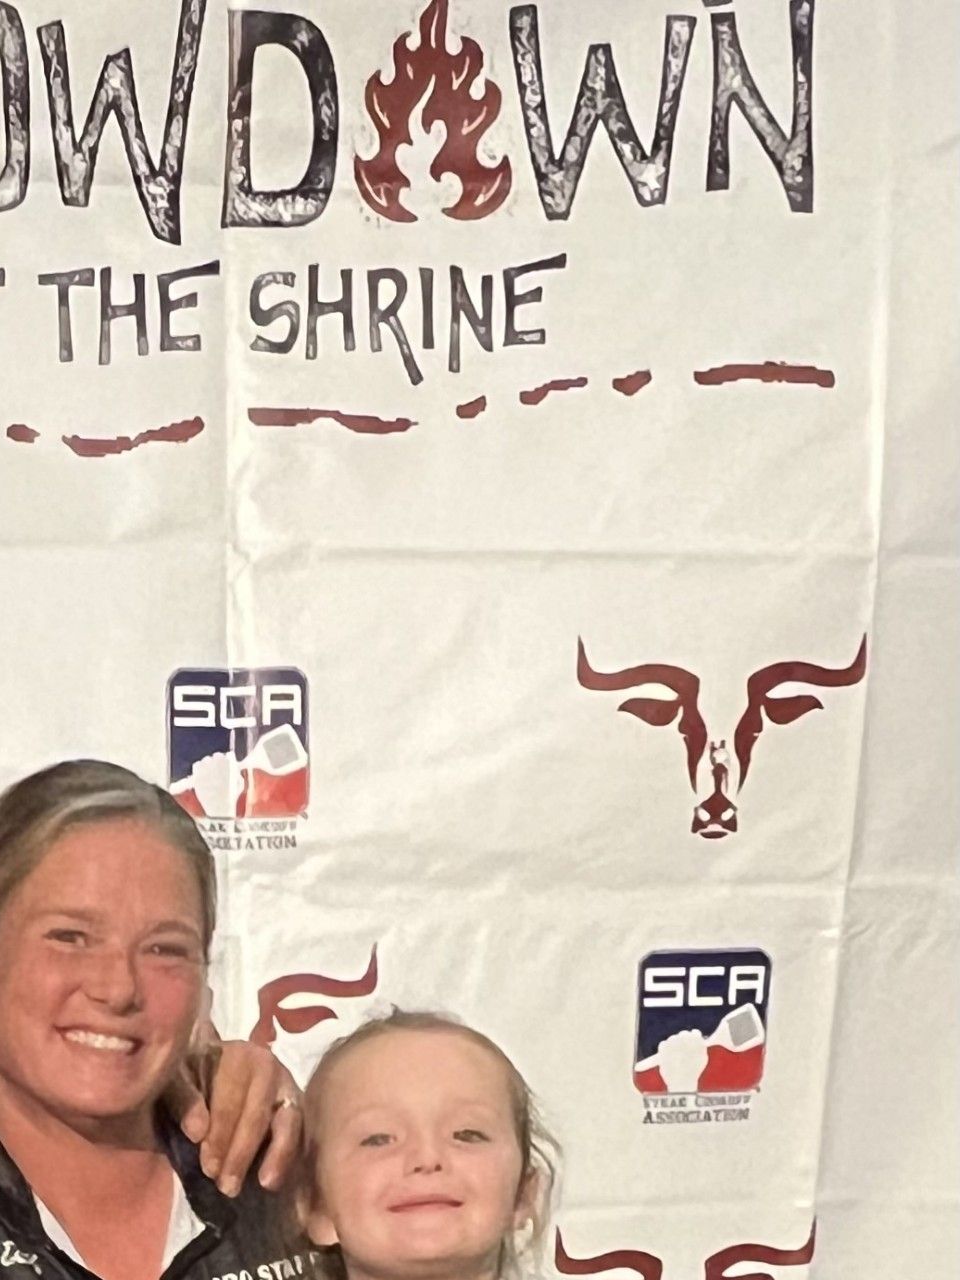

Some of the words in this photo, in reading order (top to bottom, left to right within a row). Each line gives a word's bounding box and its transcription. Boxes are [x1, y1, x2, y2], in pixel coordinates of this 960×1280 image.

[38, 260, 220, 365] THE
[249, 253, 567, 385] SHRINE
[173, 684, 302, 729] SCA
[643, 965, 766, 1008] SCA
